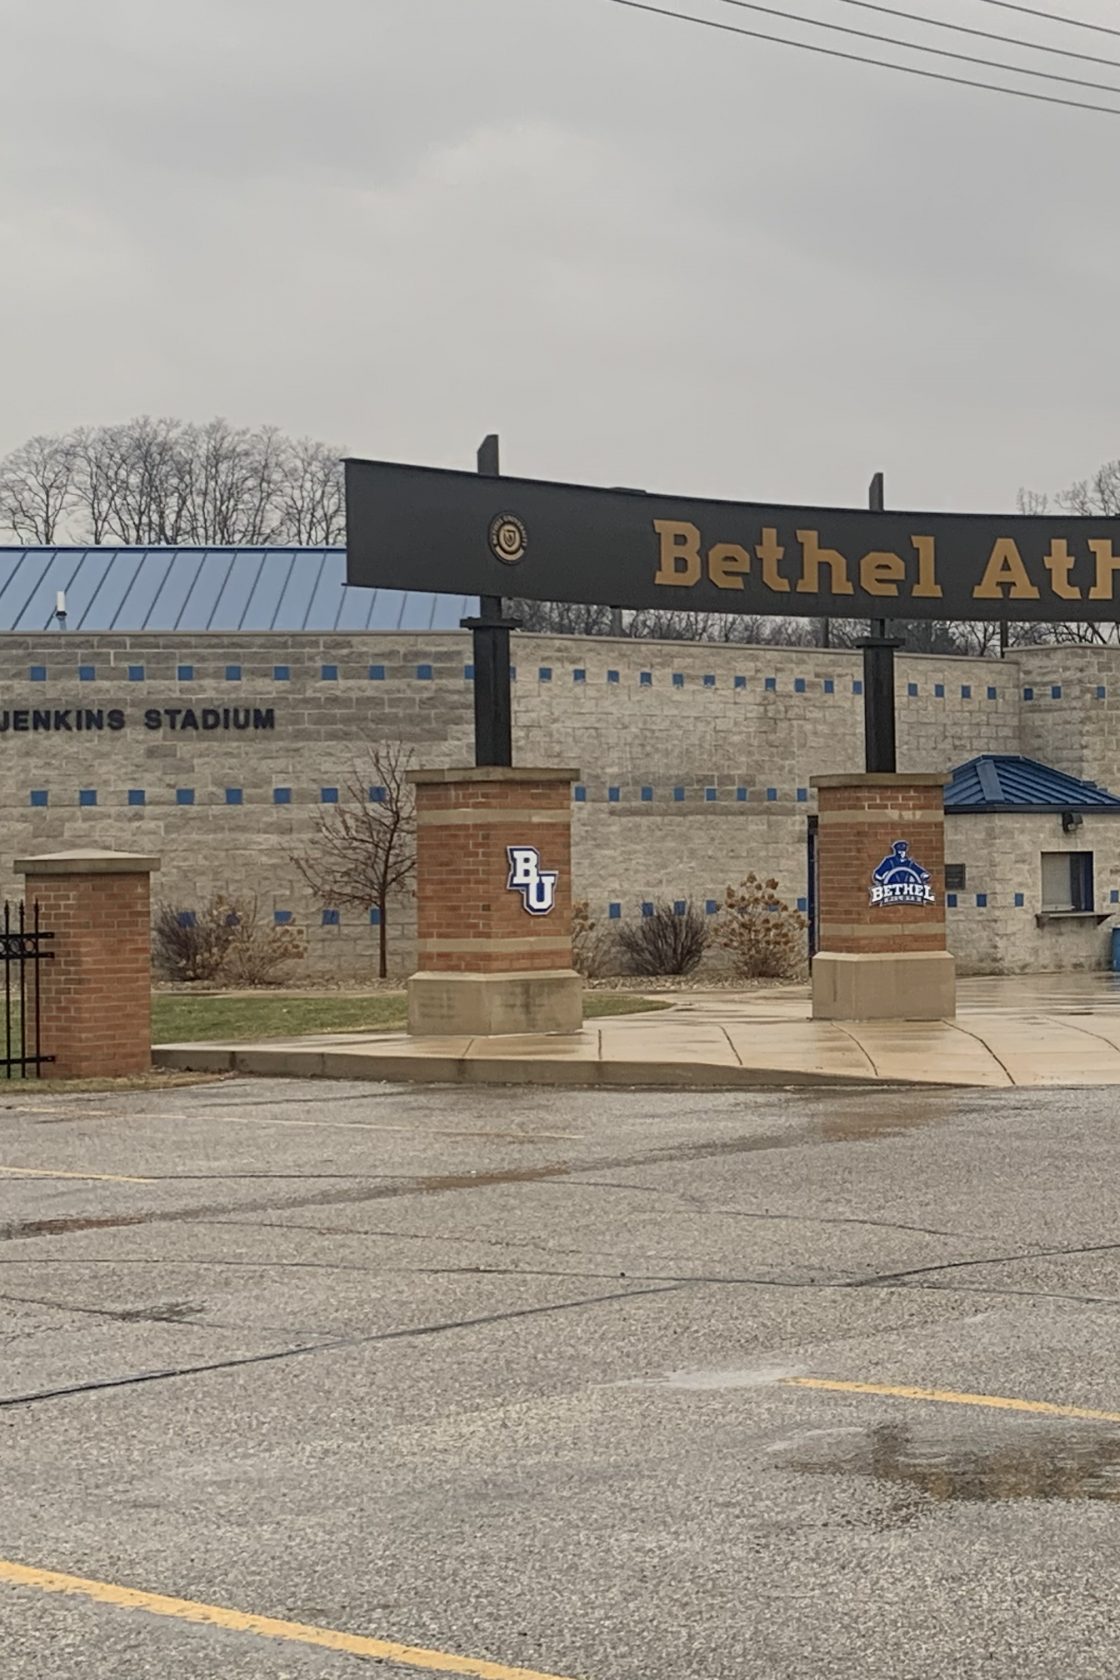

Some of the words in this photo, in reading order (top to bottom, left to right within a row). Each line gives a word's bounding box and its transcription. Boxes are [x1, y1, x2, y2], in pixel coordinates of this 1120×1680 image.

[653, 519, 943, 598] Bethel
[0, 709, 125, 731] JENKINS
[144, 709, 275, 730] STADIUM
[871, 883, 936, 902] BETHEL
